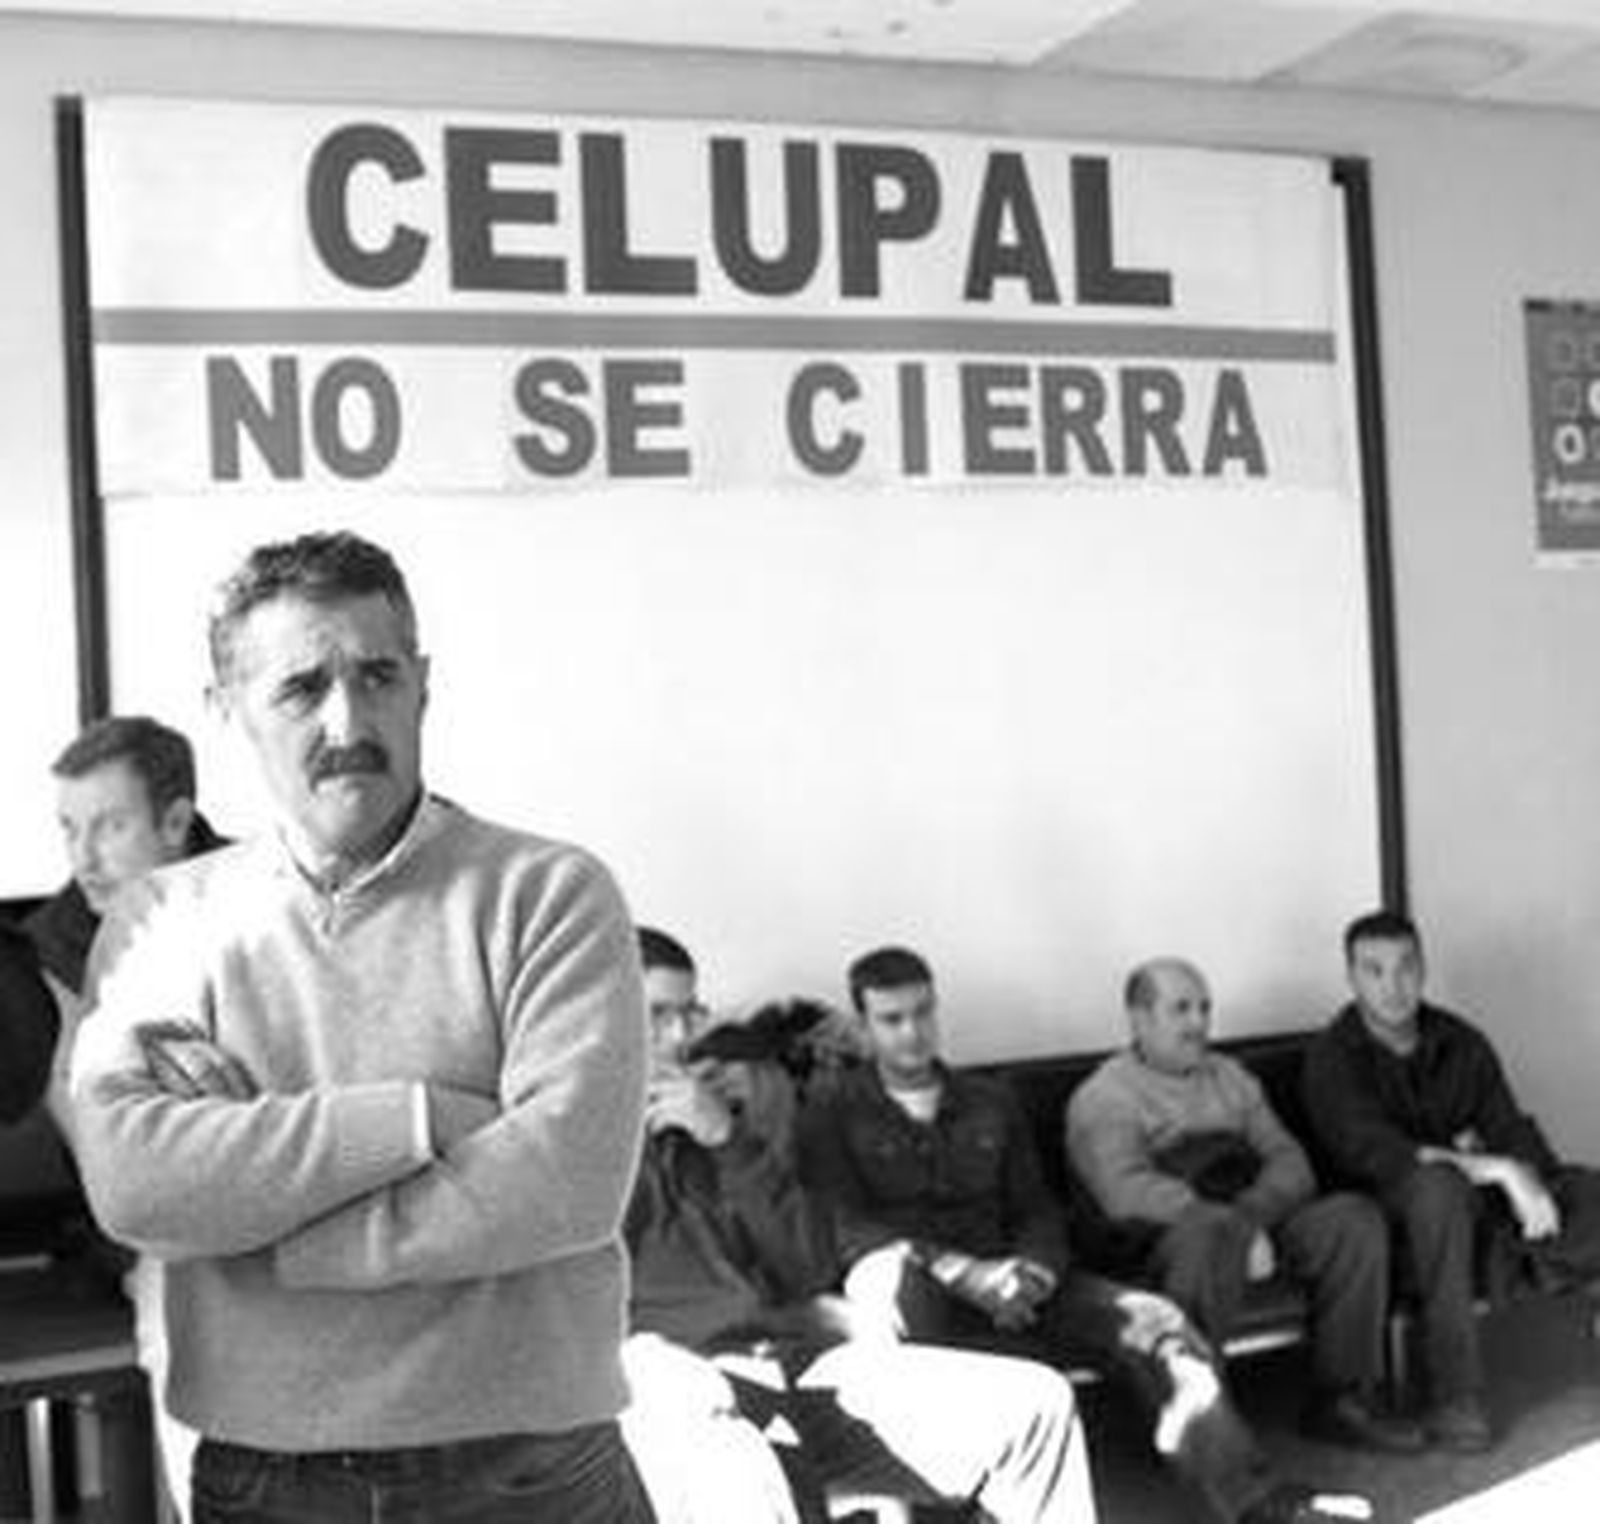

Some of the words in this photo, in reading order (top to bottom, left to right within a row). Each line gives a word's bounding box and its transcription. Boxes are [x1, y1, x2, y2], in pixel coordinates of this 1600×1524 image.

[306, 123, 1173, 309] CELUPAL
[206, 356, 401, 481] NO
[512, 358, 691, 479] SE
[786, 361, 1268, 479] CIERRA
